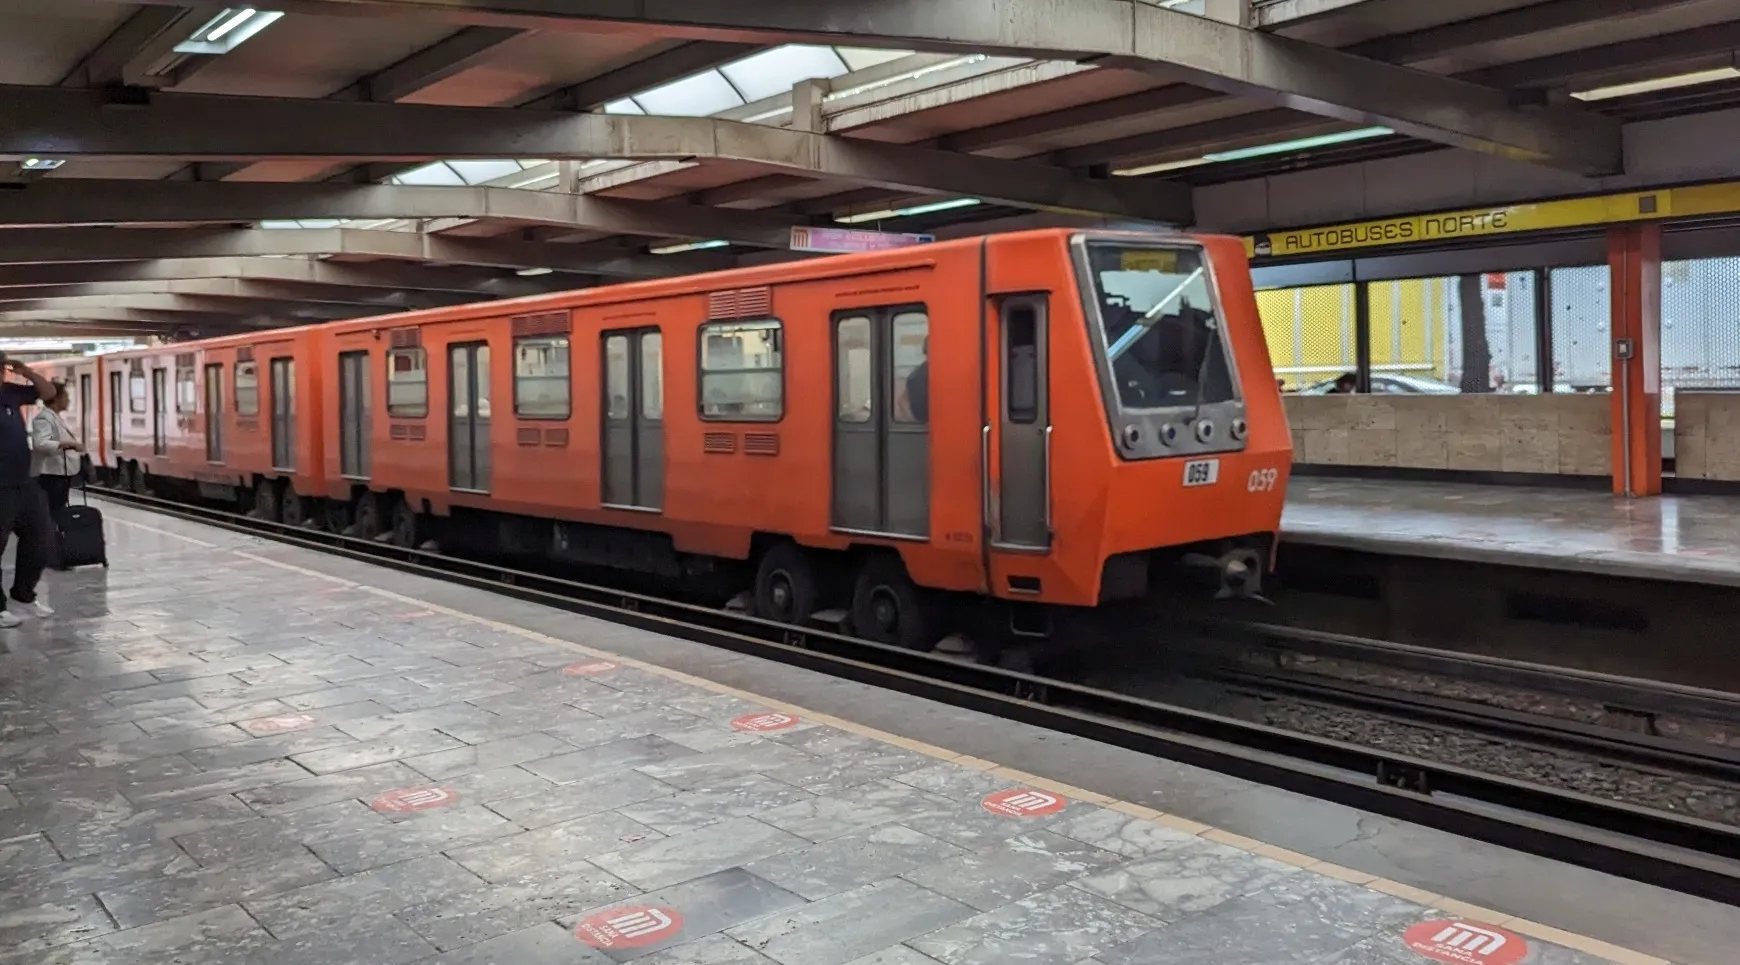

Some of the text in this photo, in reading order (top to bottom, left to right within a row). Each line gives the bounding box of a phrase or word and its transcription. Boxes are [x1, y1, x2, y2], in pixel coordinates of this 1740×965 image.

[1285, 211, 1508, 250] AUTOBUSES NORTE
[1188, 463, 1209, 483] 059
[1248, 468, 1277, 492] 059
[1412, 942, 1484, 965] DISTANCIA
[1437, 943, 1473, 956] SANA
